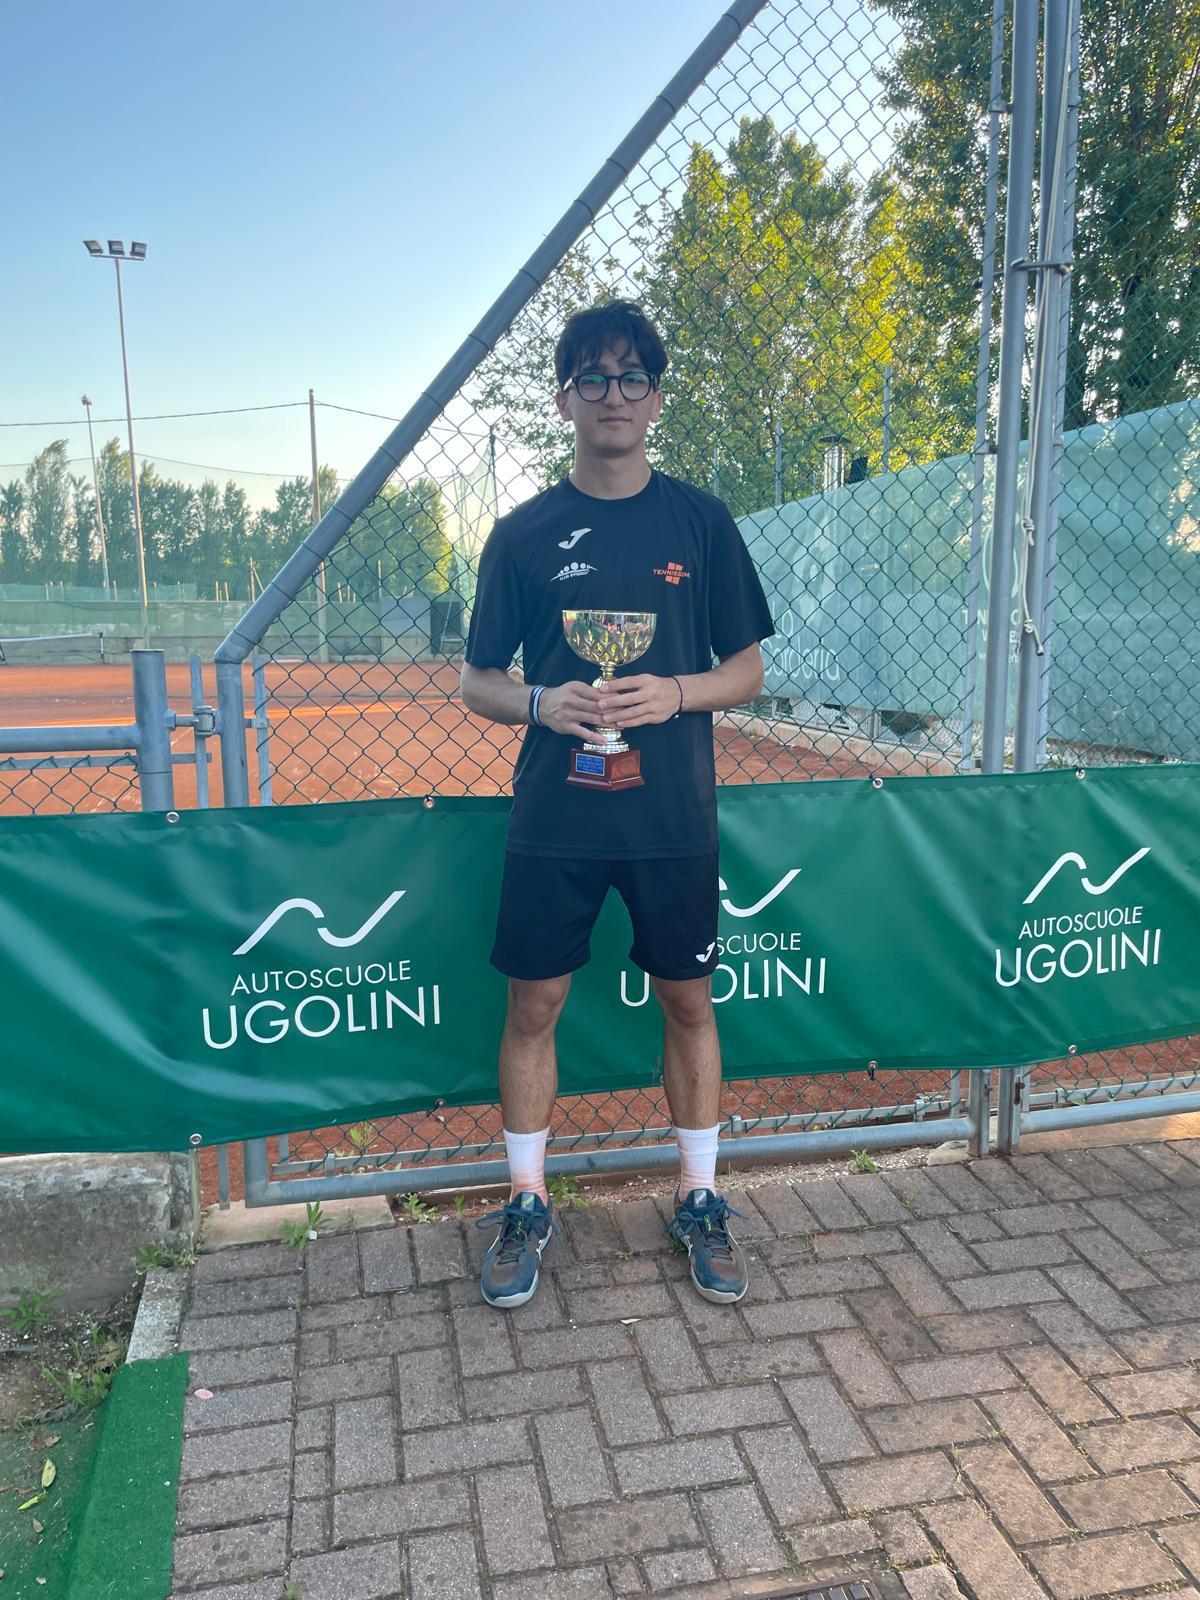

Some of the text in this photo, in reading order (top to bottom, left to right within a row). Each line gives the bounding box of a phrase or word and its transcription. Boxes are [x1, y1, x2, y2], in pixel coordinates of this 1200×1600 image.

[716, 932, 802, 956] SCUOLE
[1018, 906, 1143, 940] AUTOSCUOLE
[230, 960, 412, 997] AUTOSCUOLE
[994, 928, 1162, 988] UGOLINI
[620, 956, 826, 1007] UOLINI
[202, 984, 441, 1050] UGOLINI
